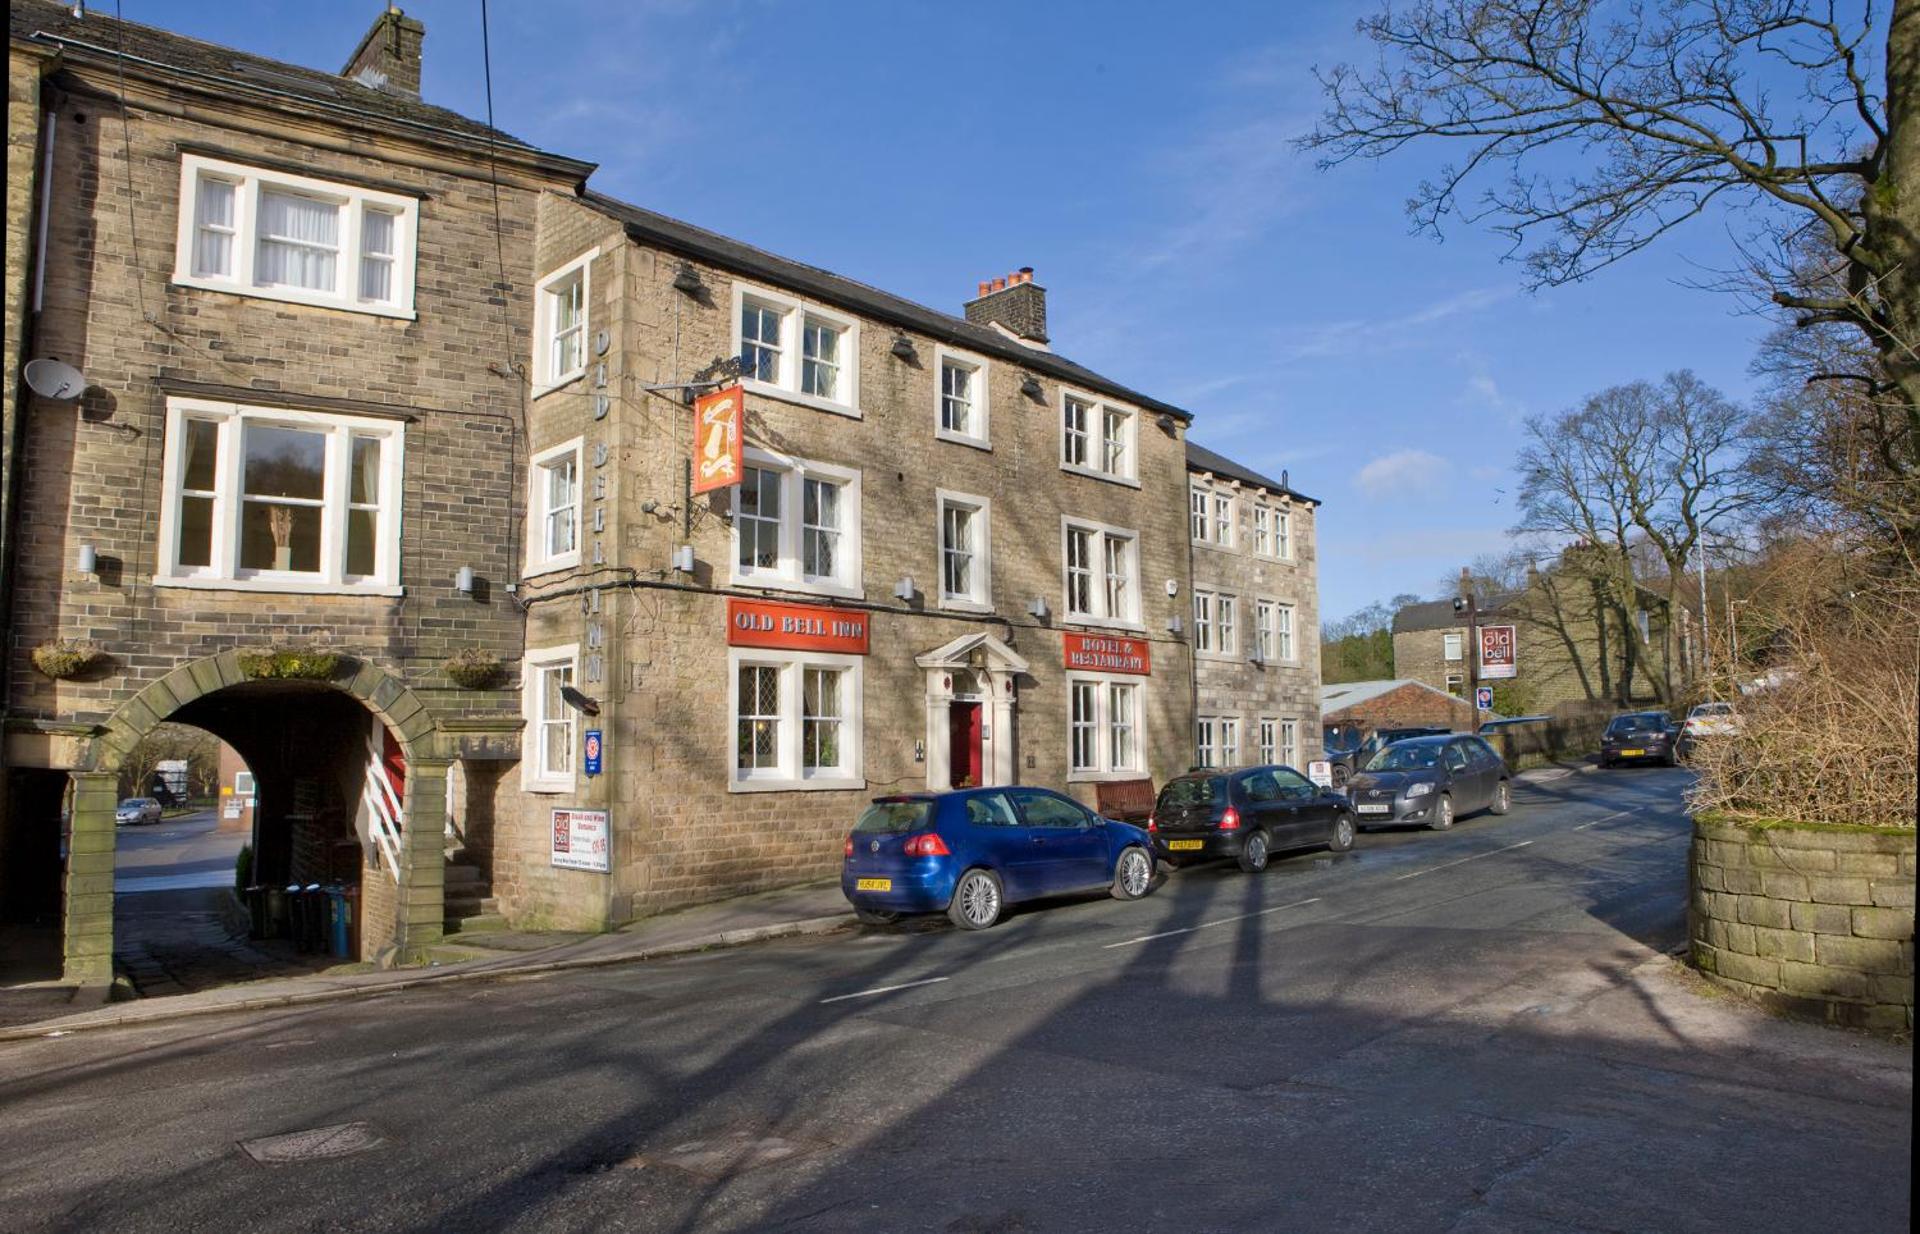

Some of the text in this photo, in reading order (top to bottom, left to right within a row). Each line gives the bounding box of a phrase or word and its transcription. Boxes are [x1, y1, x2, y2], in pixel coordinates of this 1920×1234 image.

[594, 329, 610, 421] OLD
[592, 441, 609, 566] BELL
[735, 611, 863, 638] OLD BELL INN
[1082, 637, 1134, 654] HOTEL &
[1484, 630, 1510, 645] old
[1071, 651, 1142, 669] RESTAURANT
[1484, 644, 1510, 658] bell
